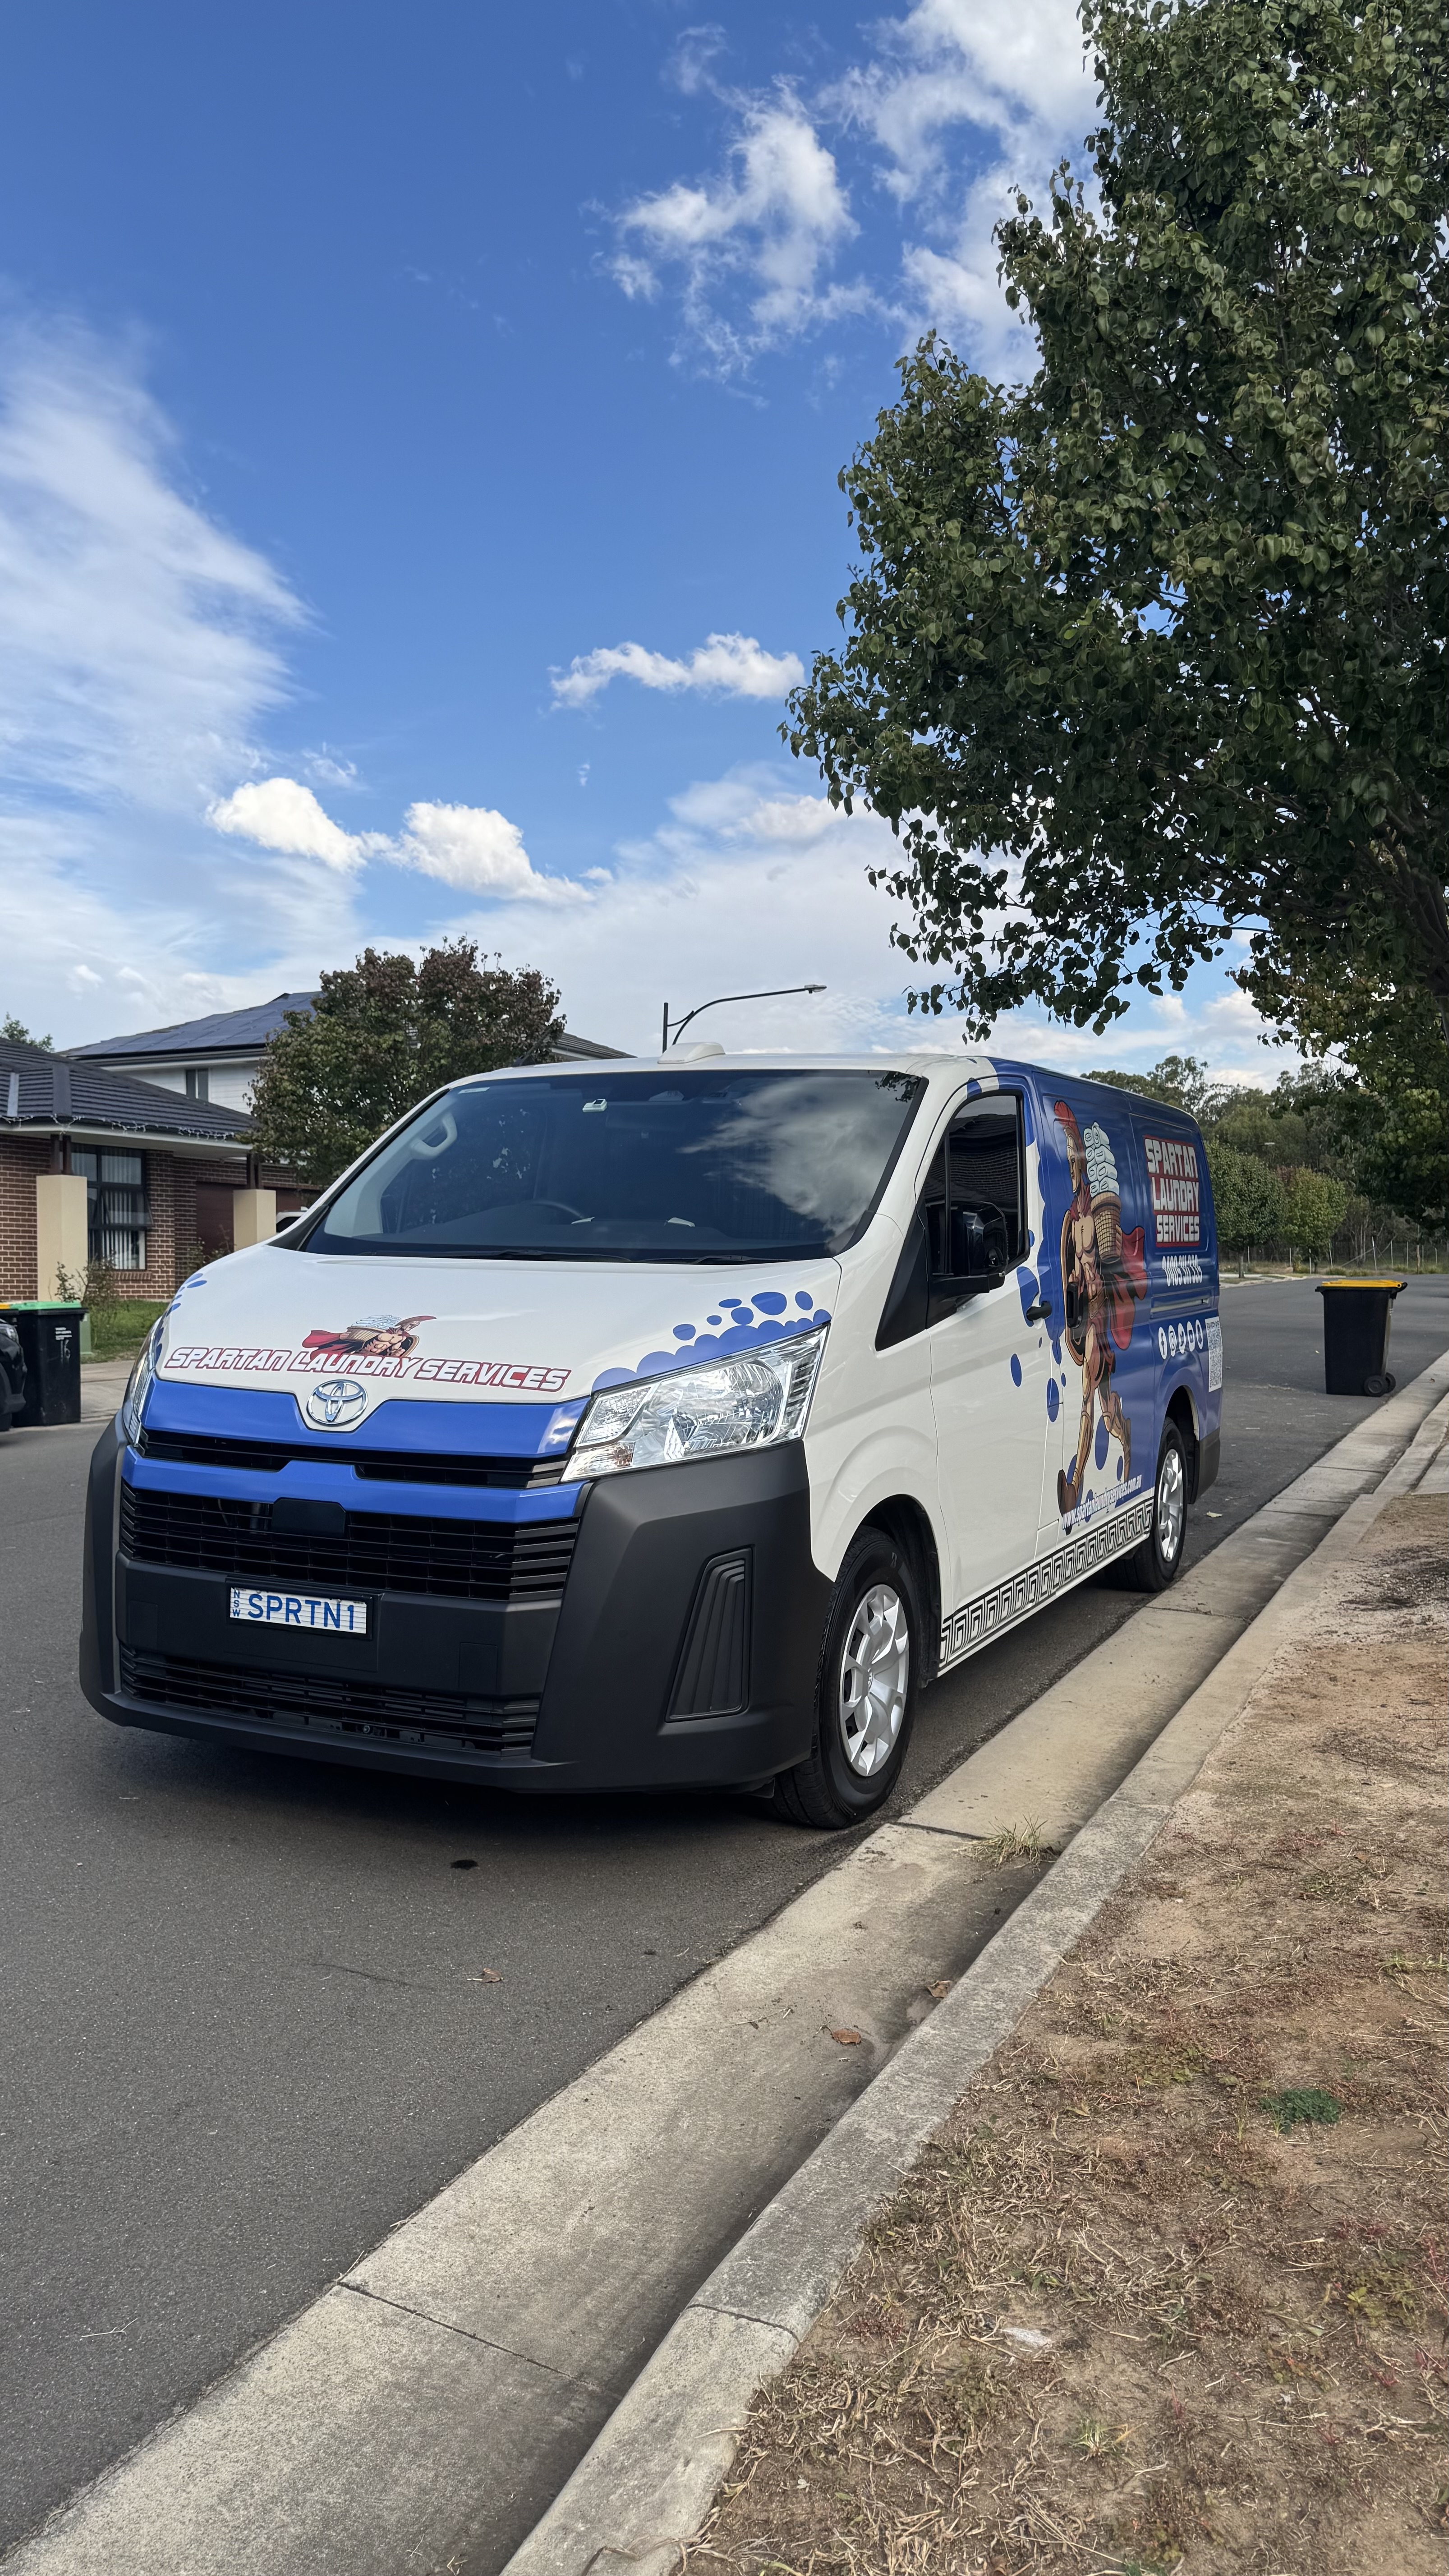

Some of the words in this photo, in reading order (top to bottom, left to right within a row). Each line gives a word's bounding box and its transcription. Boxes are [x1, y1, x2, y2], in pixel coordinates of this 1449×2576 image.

[1145, 1138, 1198, 1179] SPARTAN
[1152, 1177, 1199, 1212] LAUNDRY
[1156, 1214, 1200, 1243] SERVICES
[165, 1347, 292, 1371] SPARTAN
[287, 1352, 424, 1378] LAUNDRY
[414, 1358, 572, 1392] SERVICES
[1063, 1474, 1142, 1529] www.spartanlaundryservices.com.au
[232, 1589, 241, 1617] NSW
[248, 1593, 354, 1630] SPRTN1
